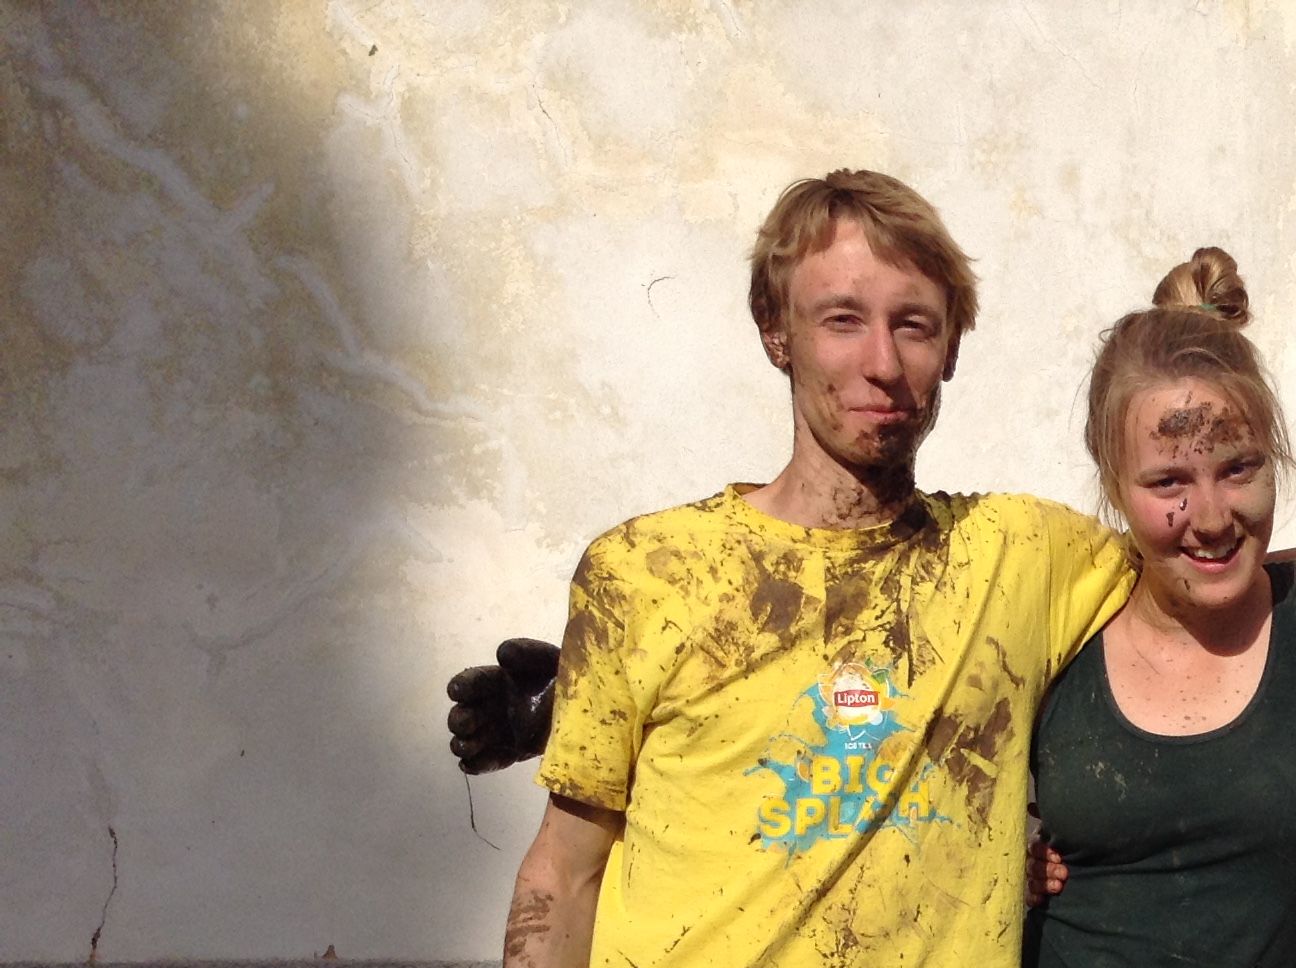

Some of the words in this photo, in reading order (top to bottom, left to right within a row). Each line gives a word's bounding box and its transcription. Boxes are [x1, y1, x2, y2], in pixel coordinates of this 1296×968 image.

[837, 692, 876, 705] Lipton
[811, 756, 899, 800] BIG
[759, 779, 929, 838] SPLAH
